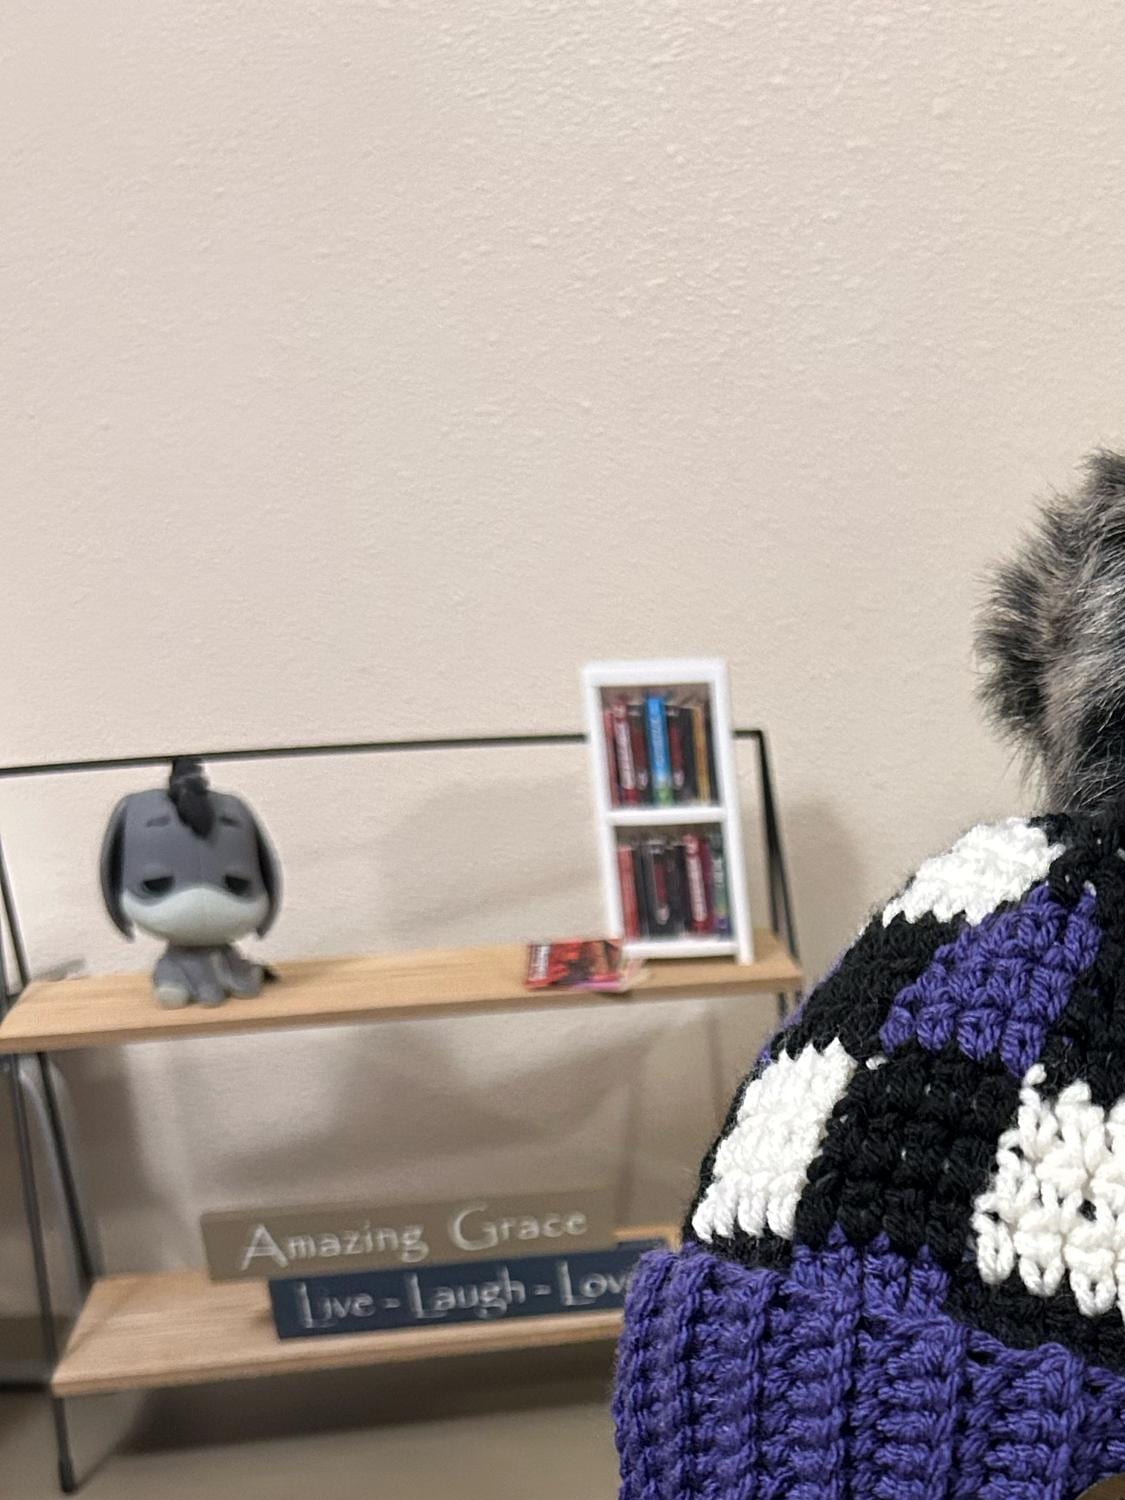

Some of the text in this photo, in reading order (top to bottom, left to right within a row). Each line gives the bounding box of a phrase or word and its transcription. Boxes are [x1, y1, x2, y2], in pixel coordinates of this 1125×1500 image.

[240, 1201, 588, 1271] Amazing Grace
[556, 1260, 632, 1307] Lov
